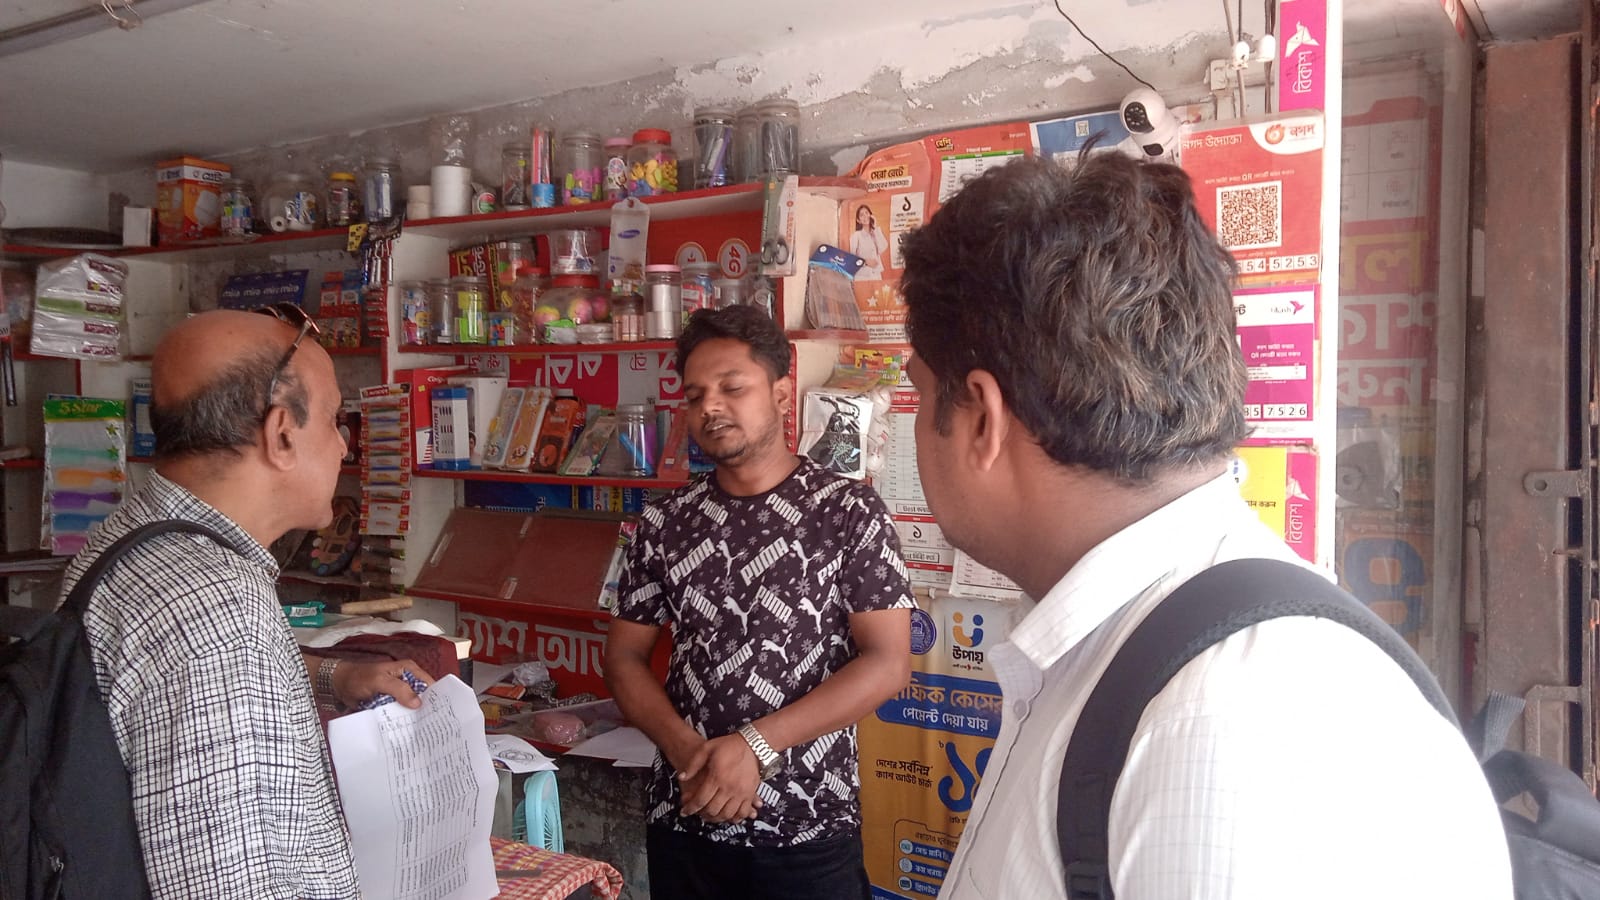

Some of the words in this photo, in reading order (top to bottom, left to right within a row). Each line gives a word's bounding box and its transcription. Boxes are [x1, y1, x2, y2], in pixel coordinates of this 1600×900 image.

[1289, 124, 1316, 137] নগদ
[728, 245, 741, 273] 4G
[1267, 406, 1306, 417] 7526
[766, 493, 803, 526] PUMA
[669, 537, 716, 586] PUMA
[740, 536, 789, 586] PUMA
[683, 584, 718, 621] PUMA
[757, 584, 793, 624] PUMA
[716, 642, 754, 681] PUMA
[793, 642, 825, 681] PUMA
[952, 645, 984, 664] উপায়
[745, 671, 786, 710] PUMA
[902, 706, 939, 724] পেমেন্ট
[942, 714, 965, 729] দেয়া
[967, 715, 989, 732] যায়
[801, 730, 844, 773] PUMA
[876, 758, 897, 769] দেশের
[823, 770, 851, 801] PUMA
[875, 769, 894, 780] ক্যাশ
[895, 773, 917, 785] আউট
